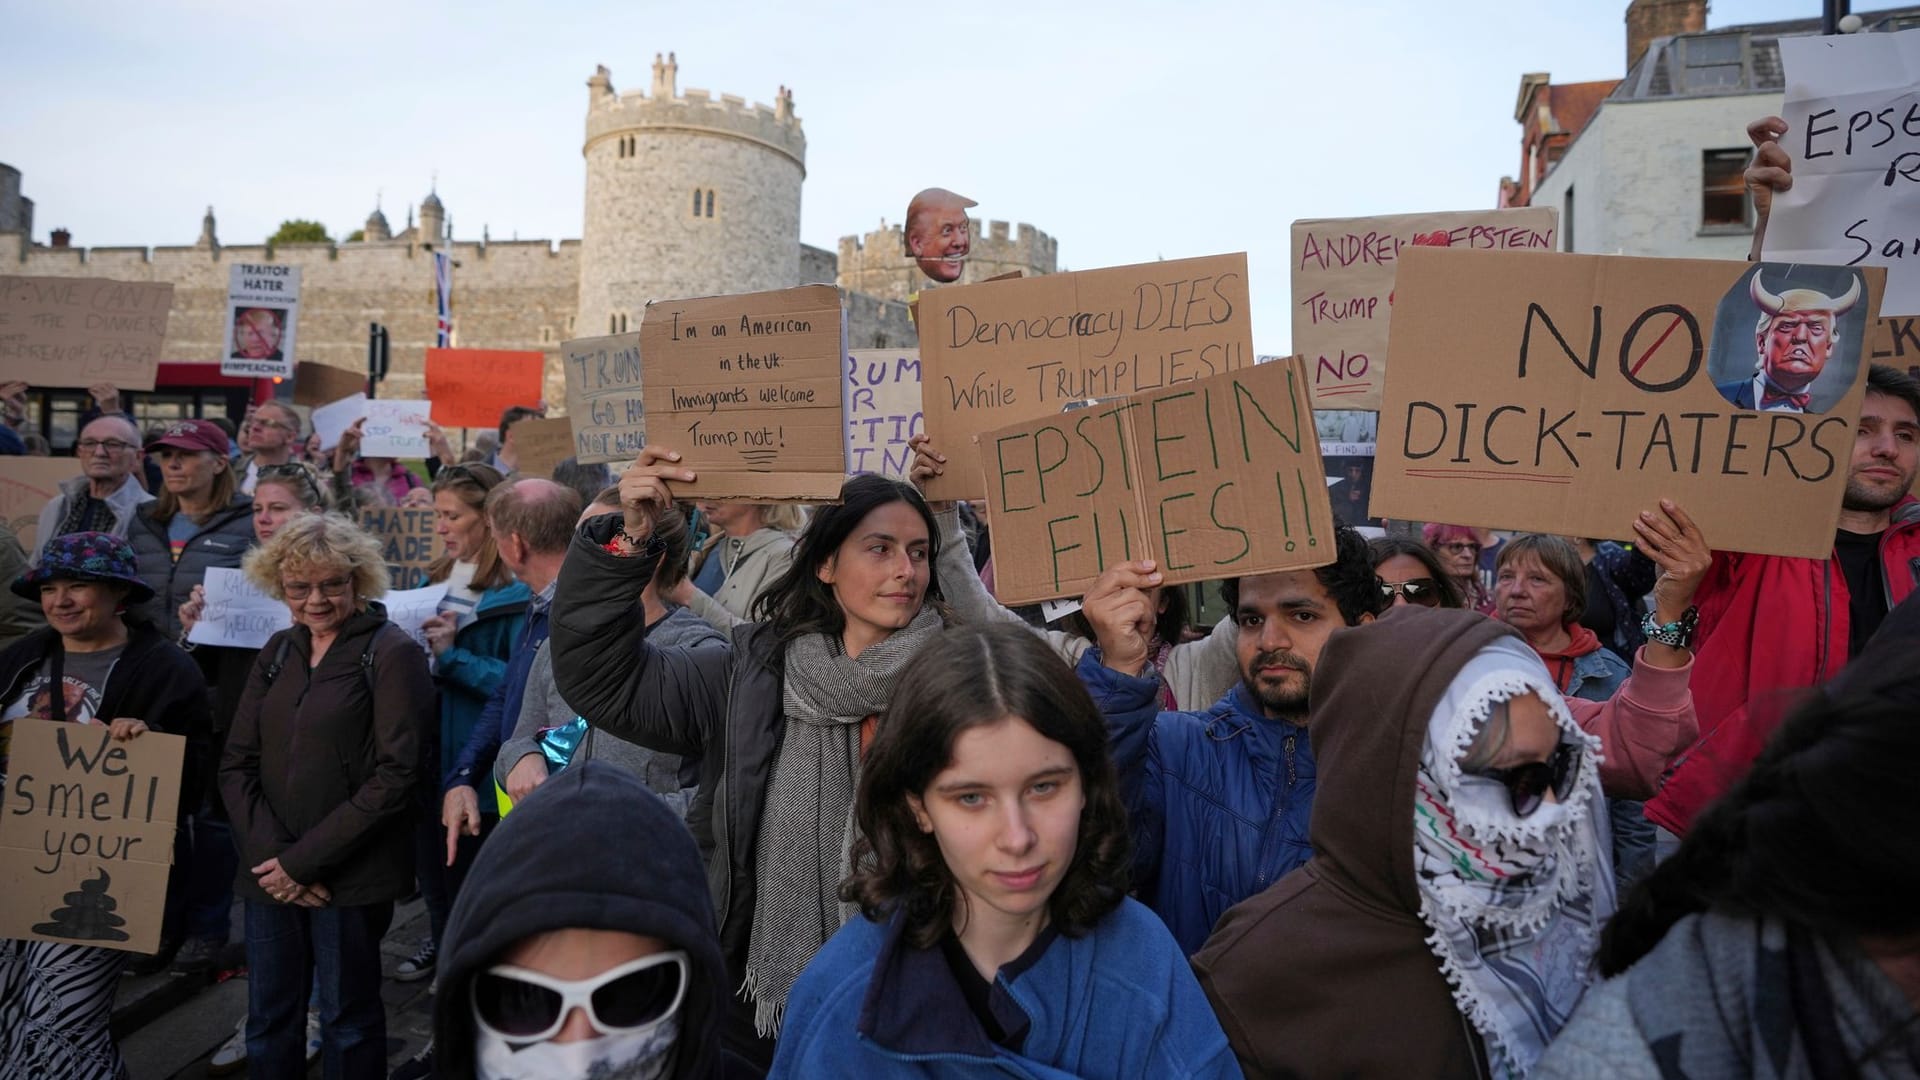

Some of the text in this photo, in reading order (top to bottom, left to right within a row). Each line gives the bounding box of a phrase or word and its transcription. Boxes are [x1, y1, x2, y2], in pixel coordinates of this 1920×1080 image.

[1301, 226, 1553, 272] ANDRE EPSTEIN
[241, 264, 290, 276] TRAITOR
[32, 282, 81, 306] WE
[243, 279, 284, 292] HATER
[947, 273, 1239, 358] Democracy DIES
[1302, 291, 1378, 324] TRUMP
[711, 324, 727, 337] an
[740, 314, 812, 337] American
[719, 357, 731, 371] in
[738, 352, 761, 371] the
[1518, 302, 1703, 392] NO
[1316, 350, 1369, 384] NO
[672, 388, 815, 414] Immigrants welcome
[943, 371, 1017, 411] While
[591, 400, 616, 425] GO
[578, 432, 611, 456] NOT
[688, 421, 738, 451] Trump
[997, 369, 1301, 513] EPSTEIN
[1335, 445, 1358, 455] FIND
[1403, 401, 1848, 482] DICK-TATERS
[363, 510, 435, 534] HATE
[56, 727, 129, 776] We
[34, 829, 142, 874] your
